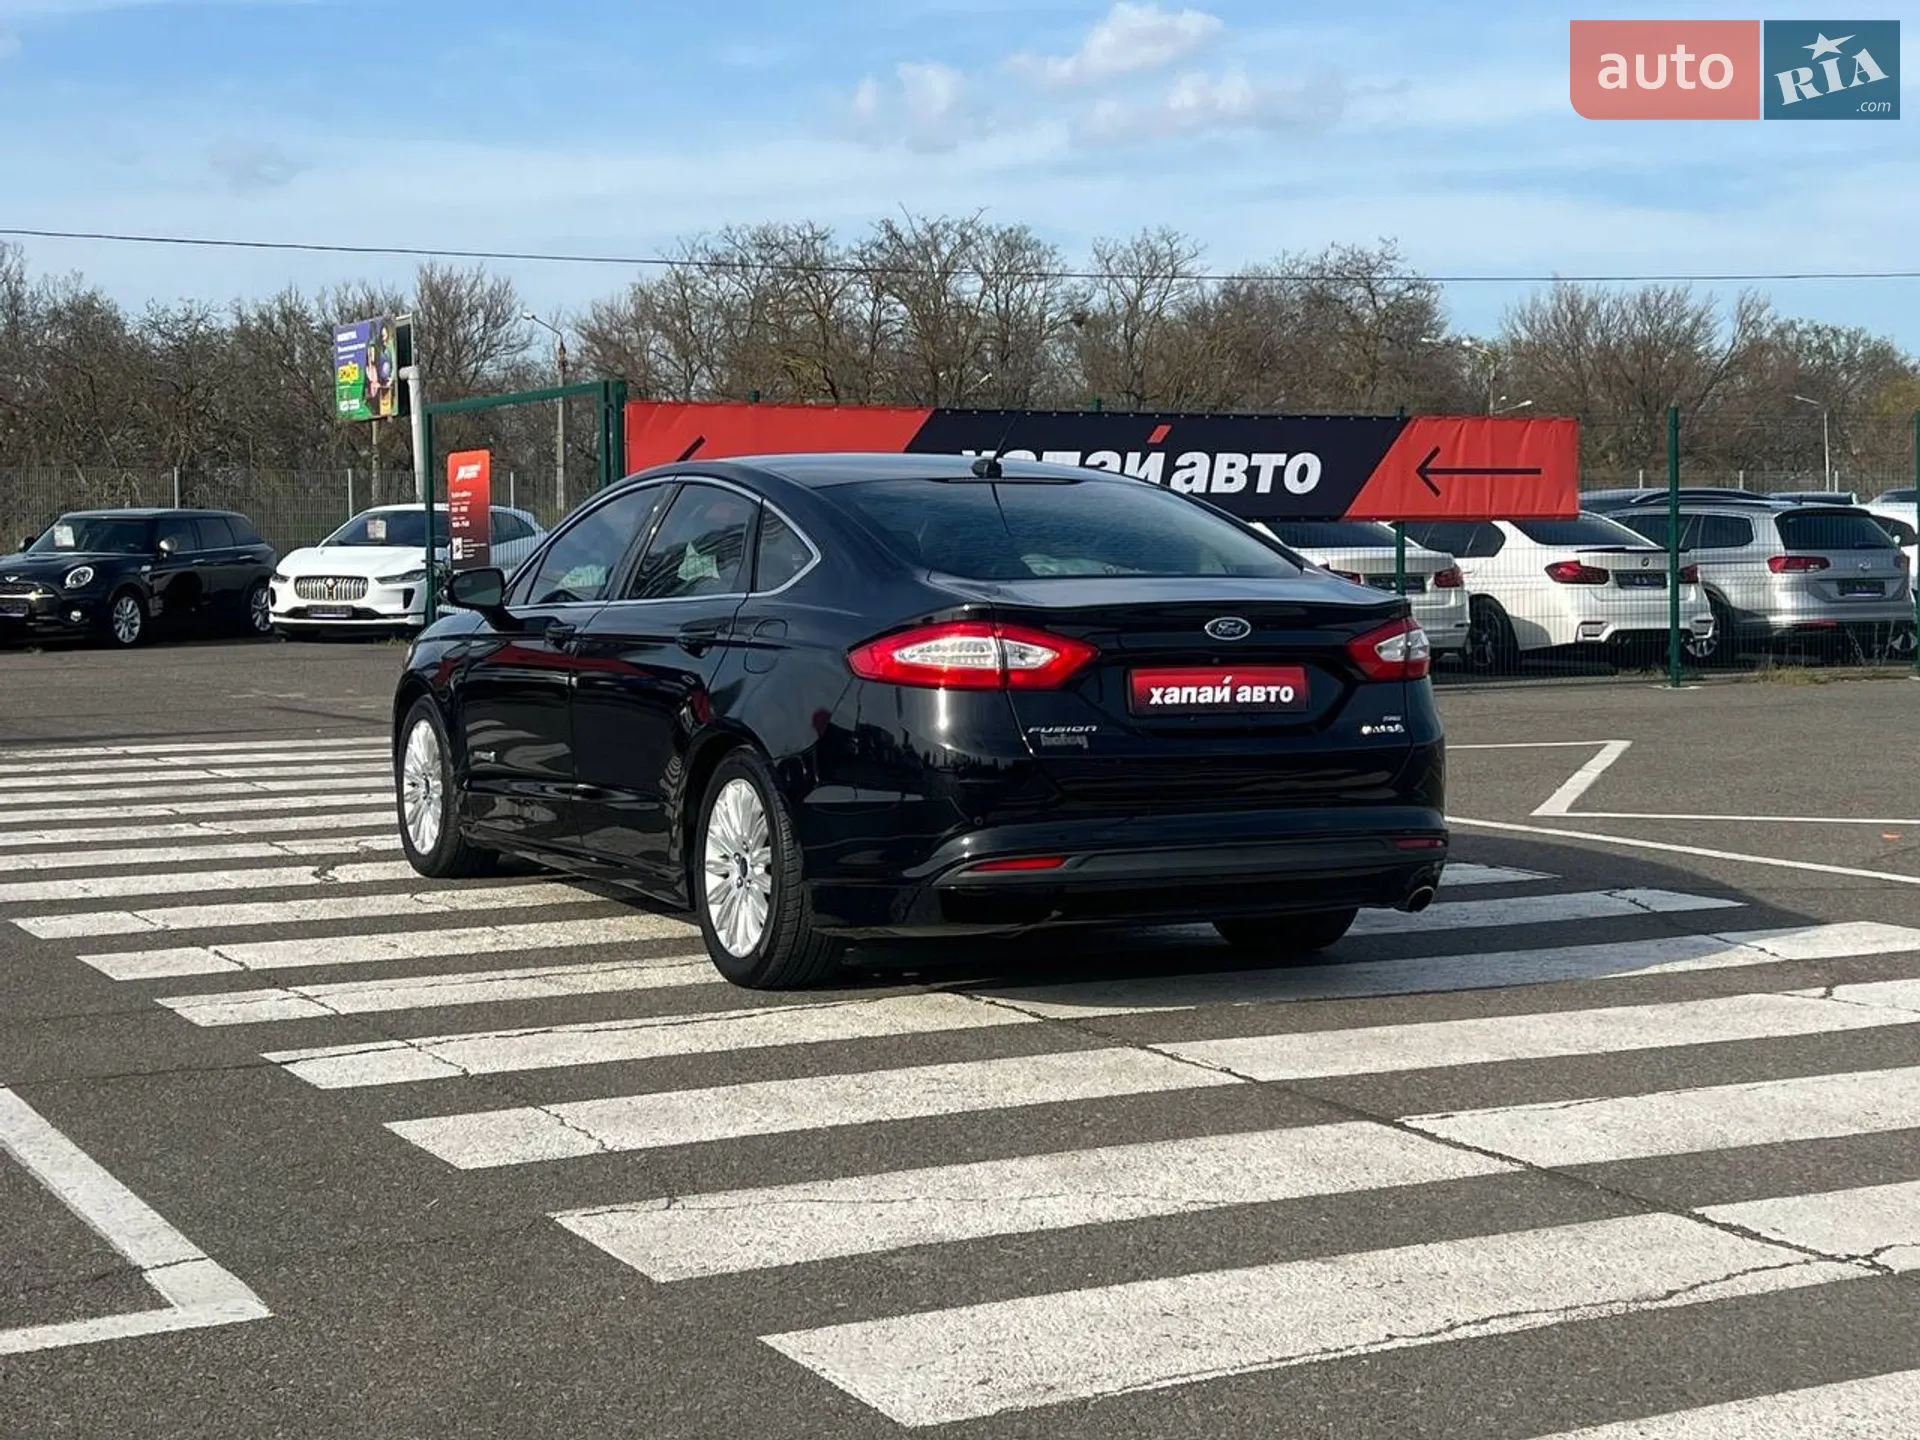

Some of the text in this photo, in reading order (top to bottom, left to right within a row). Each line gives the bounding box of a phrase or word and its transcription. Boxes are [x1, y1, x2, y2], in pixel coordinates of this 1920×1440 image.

[1170, 450, 1323, 495] авто
[1149, 676, 1295, 705] хапай авто
[1027, 725, 1098, 734] FUSION
